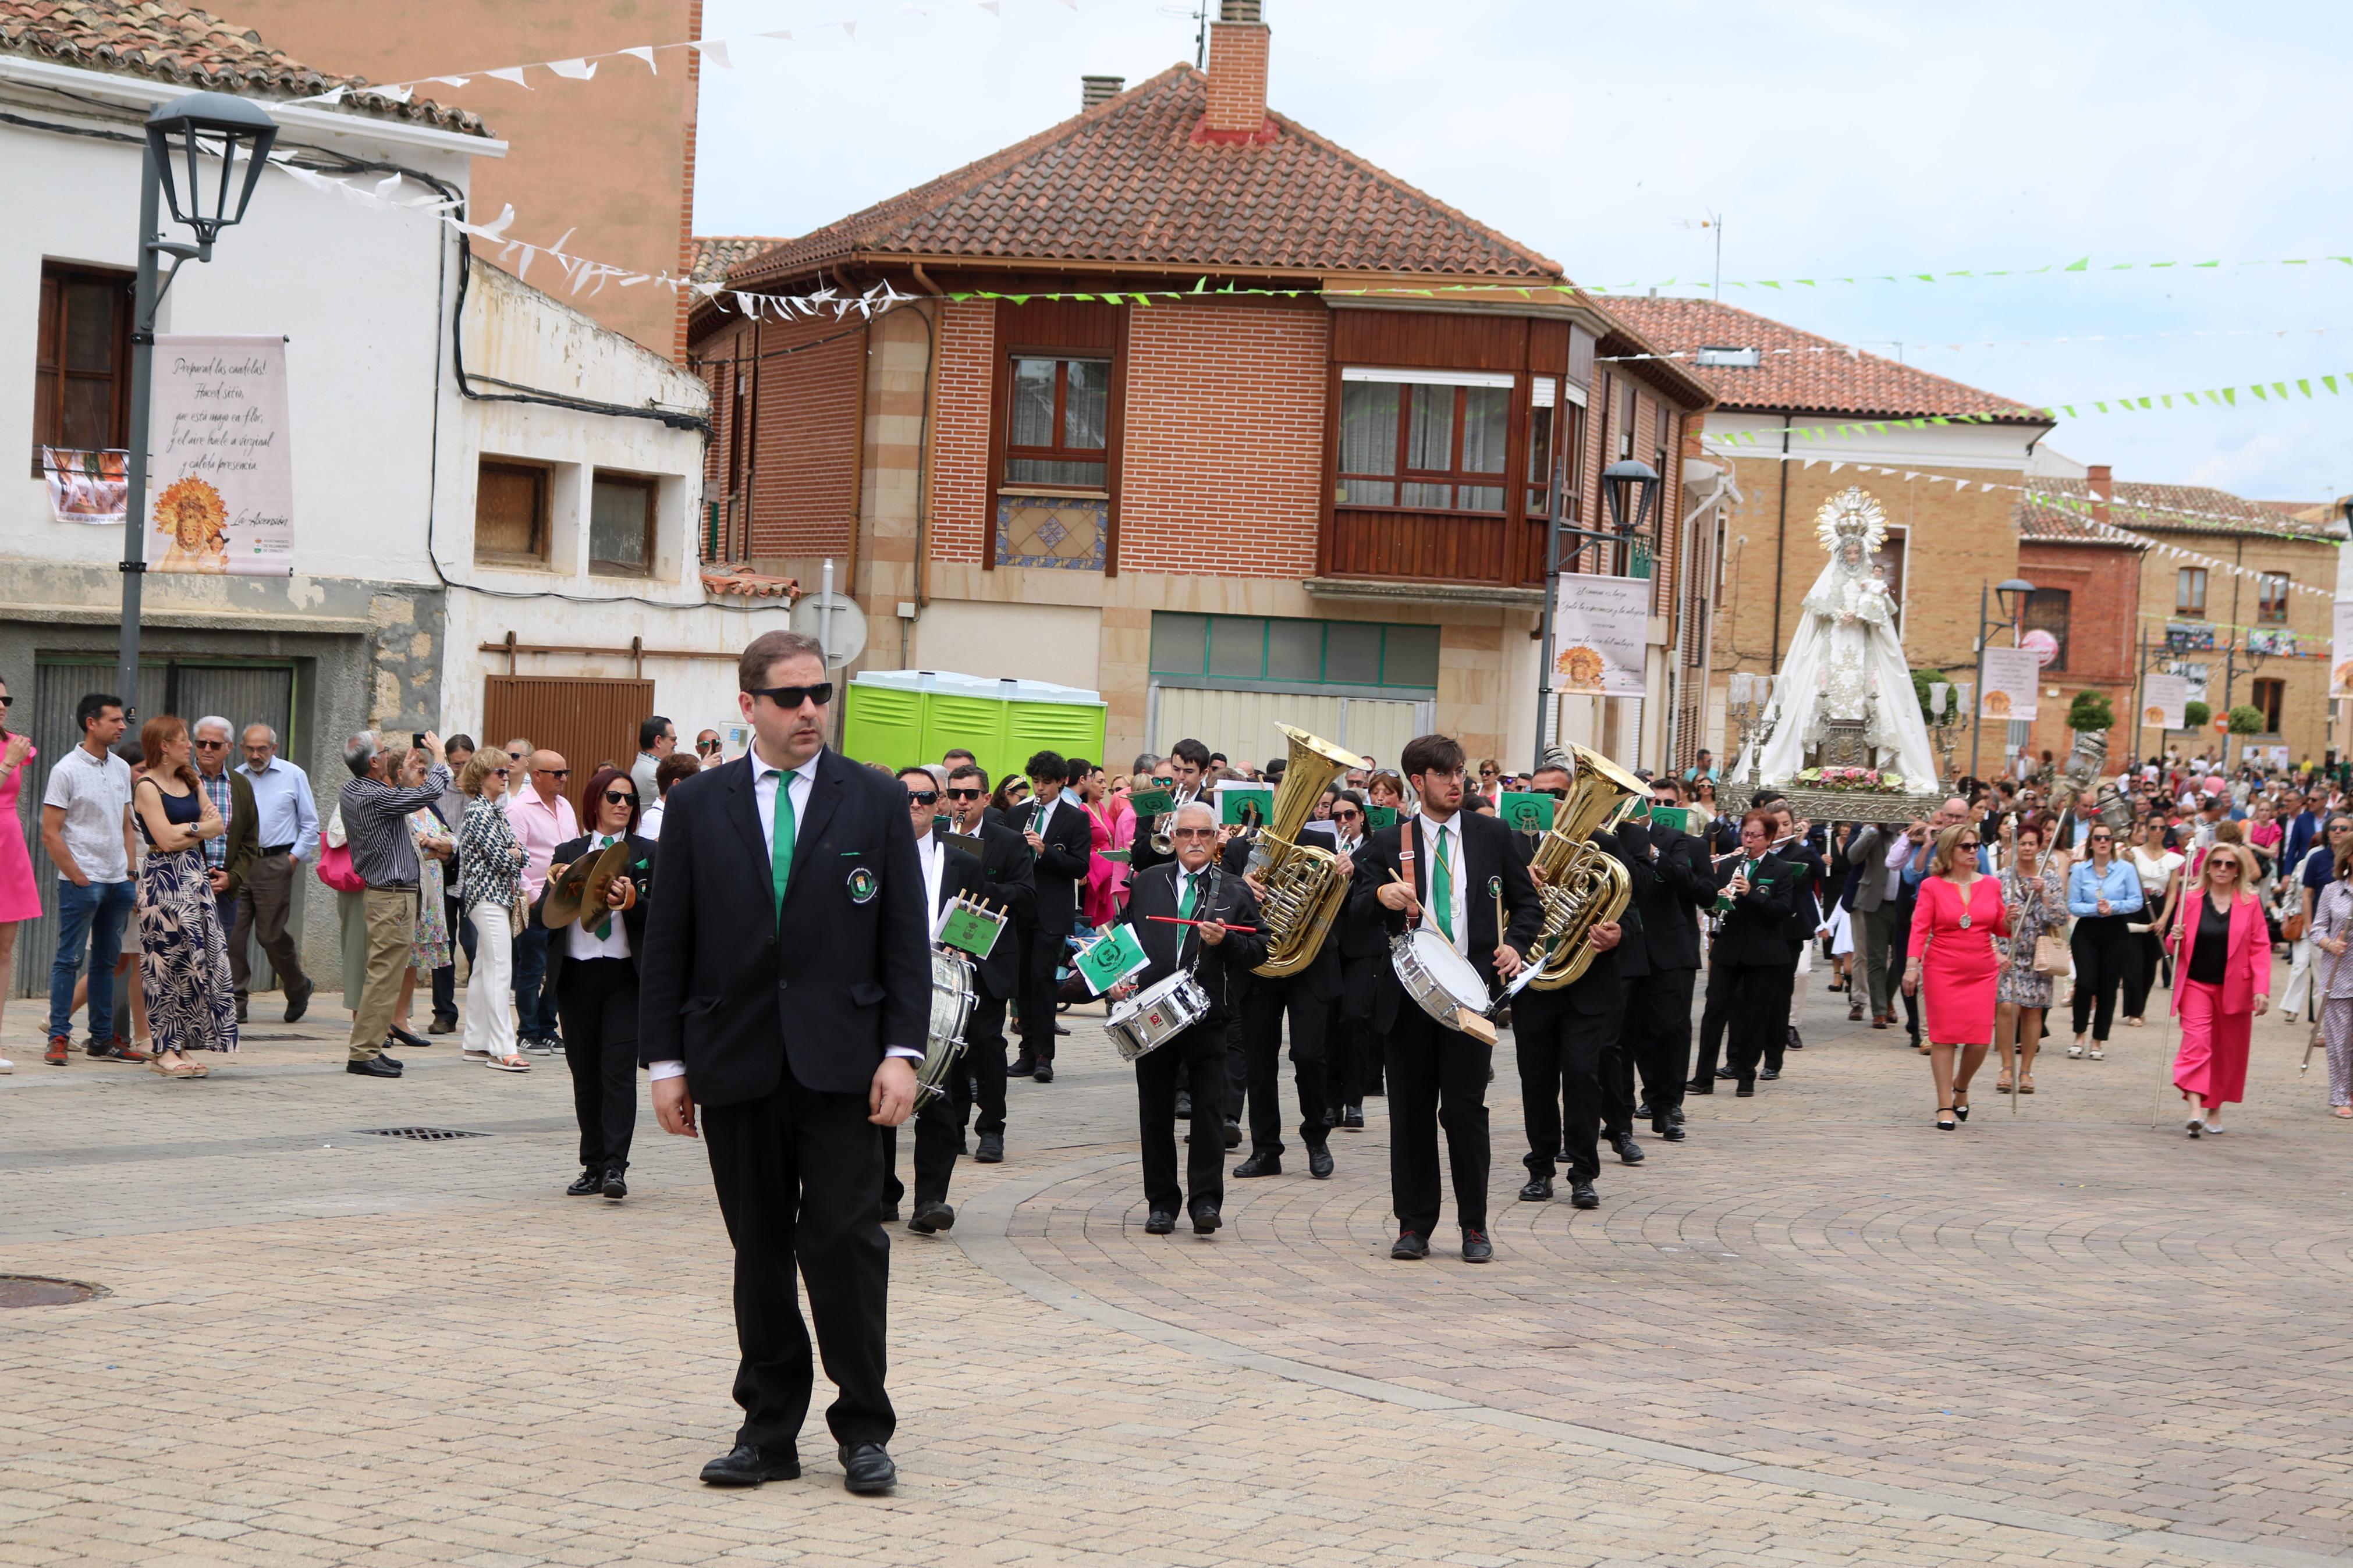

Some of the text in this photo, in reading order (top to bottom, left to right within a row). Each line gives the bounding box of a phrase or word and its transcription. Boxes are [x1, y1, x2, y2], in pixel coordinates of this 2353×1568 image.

[172, 357, 215, 377] Preparad
[215, 358, 226, 375] las
[194, 381, 223, 400] Haced
[172, 412, 188, 436] que
[210, 413, 229, 431] mayo
[231, 414, 240, 422] en
[166, 428, 275, 457] y el aire huele a virginal
[178, 461, 187, 477] y
[189, 453, 215, 471] cálida
[230, 508, 249, 527] La
